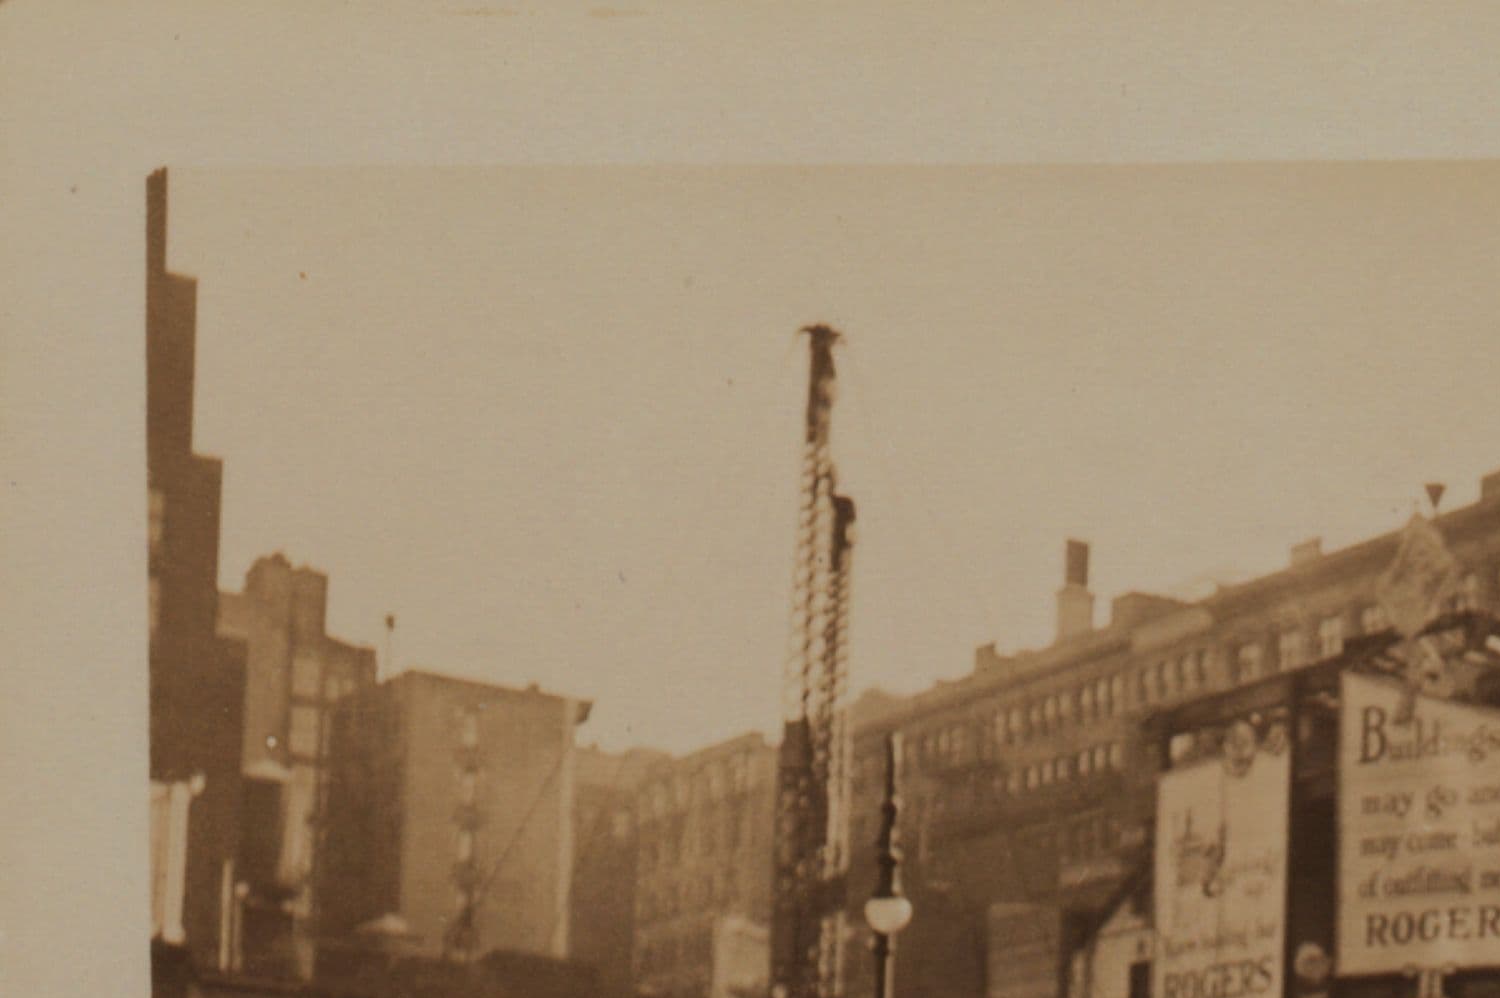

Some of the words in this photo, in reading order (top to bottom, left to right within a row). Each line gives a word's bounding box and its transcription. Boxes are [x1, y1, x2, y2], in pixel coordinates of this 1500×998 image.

[1360, 790, 1415, 818] may
[1425, 786, 1458, 819] go
[1359, 834, 1399, 860] may
[1358, 874, 1377, 901] of
